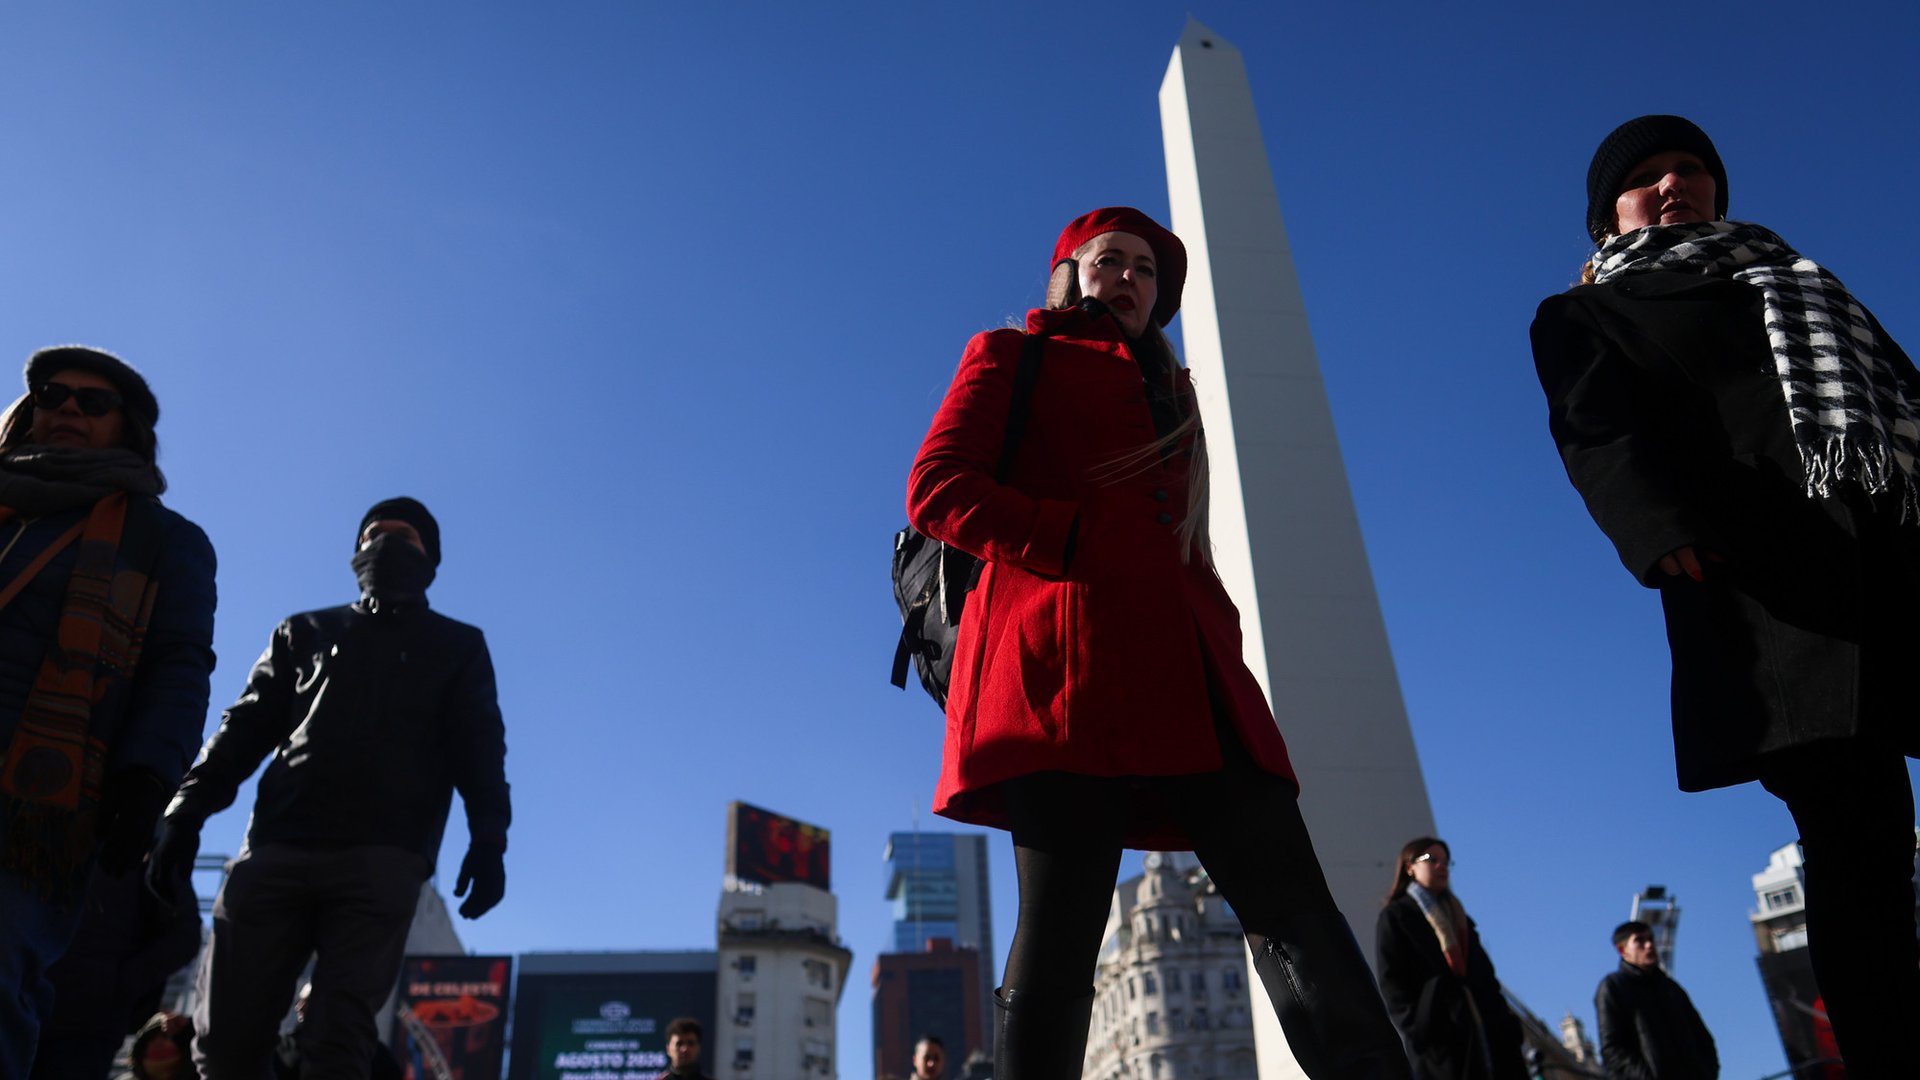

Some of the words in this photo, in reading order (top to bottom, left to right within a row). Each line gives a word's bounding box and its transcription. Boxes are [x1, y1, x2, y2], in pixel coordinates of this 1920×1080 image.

[409, 983, 430, 996] DE
[433, 983, 501, 996] CELESTE
[555, 1052, 624, 1068] AGOSTO
[626, 1052, 668, 1068] 2026
